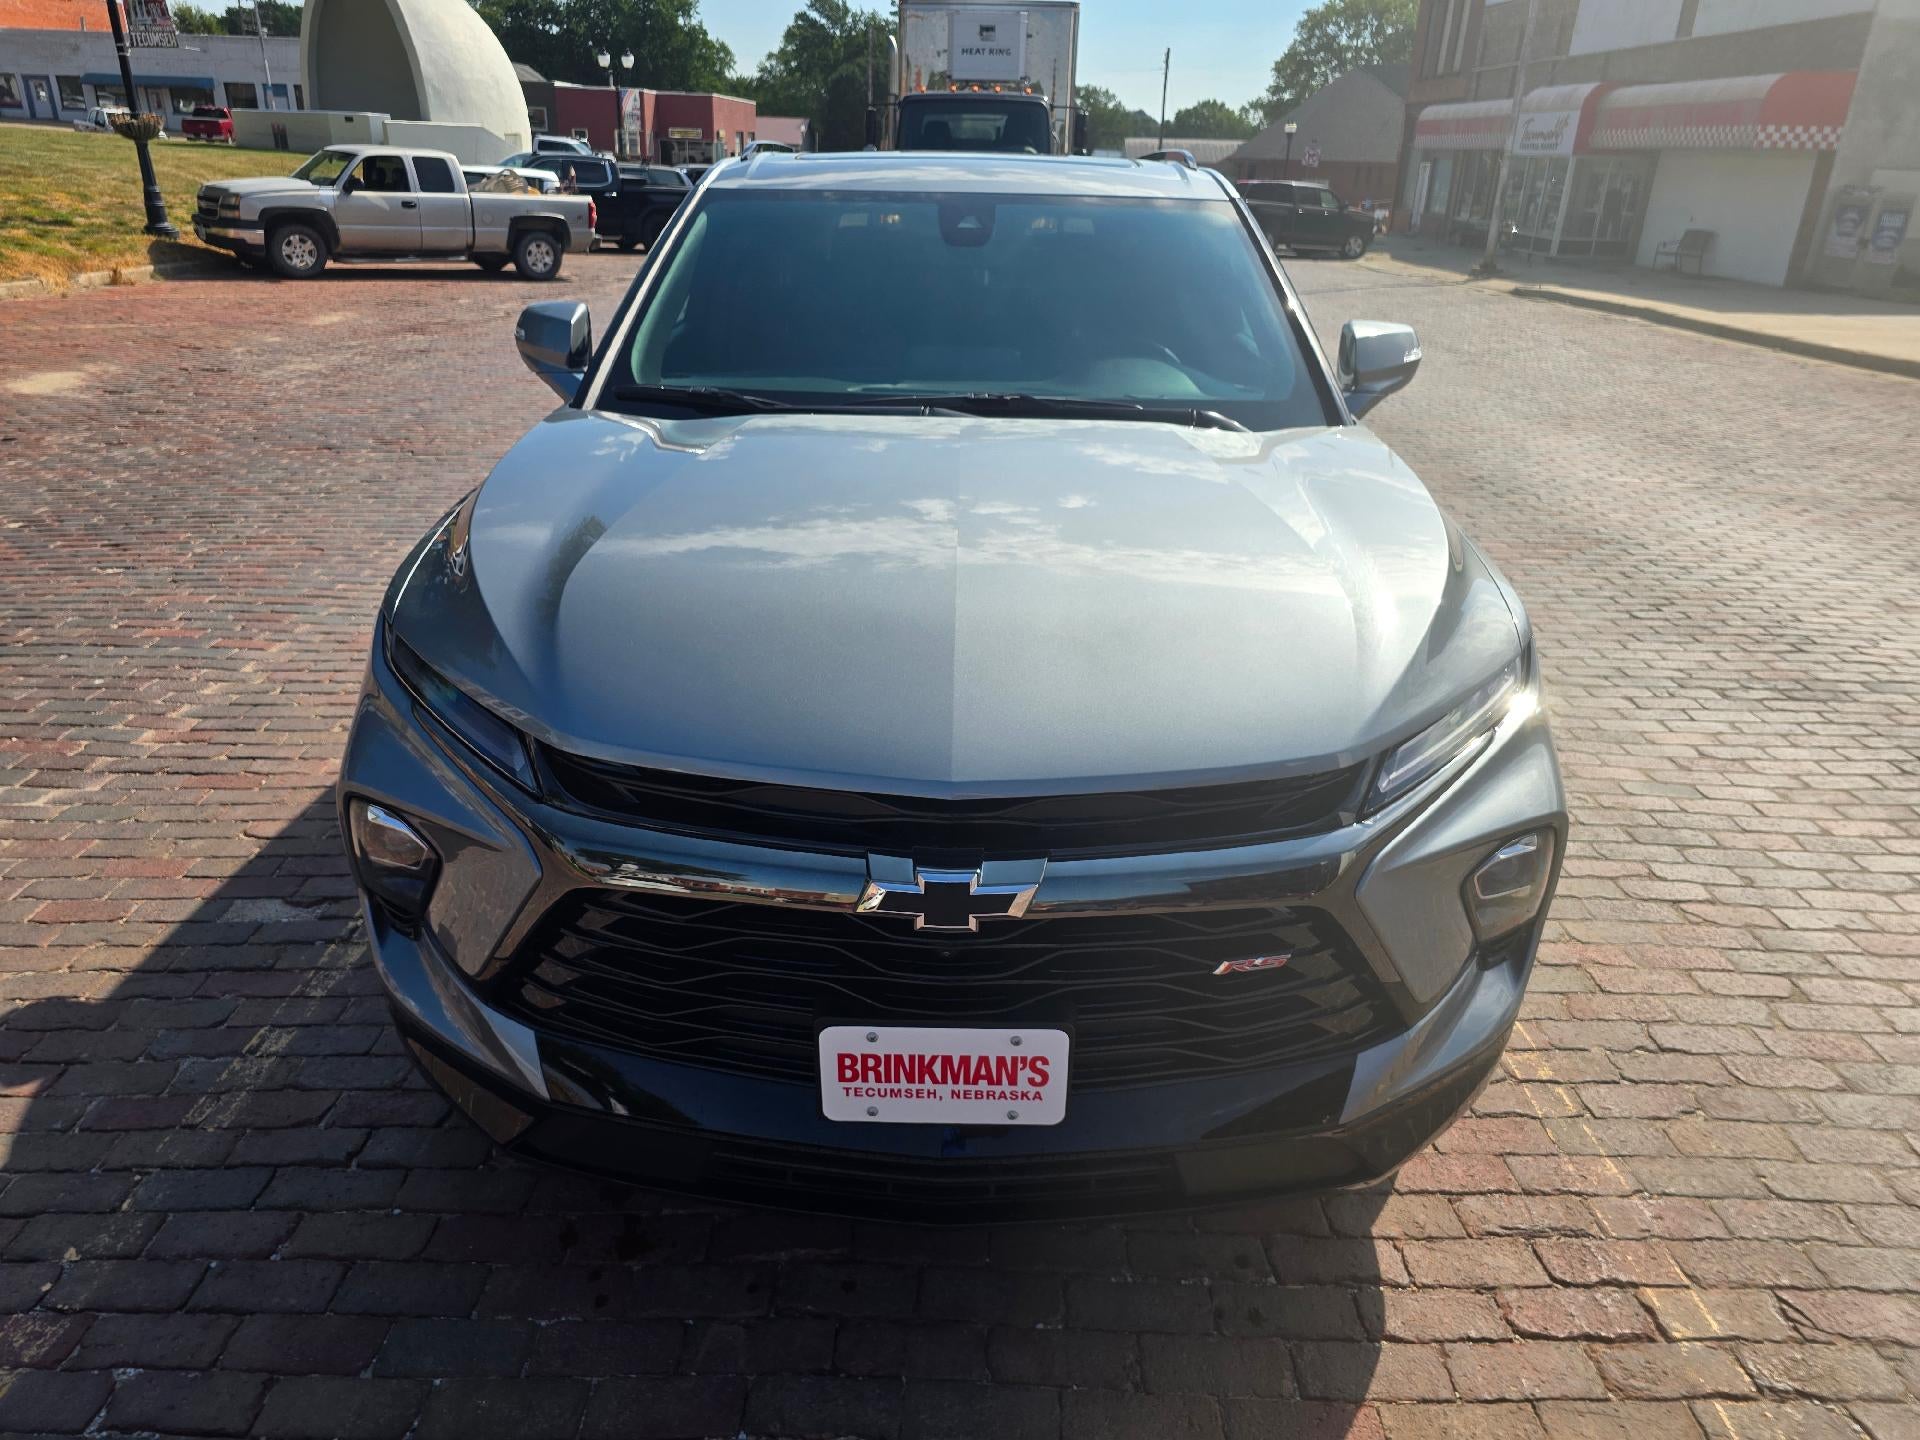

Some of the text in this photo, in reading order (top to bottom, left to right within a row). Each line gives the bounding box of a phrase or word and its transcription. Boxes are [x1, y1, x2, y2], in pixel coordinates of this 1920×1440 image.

[130, 31, 177, 47] TECUMSEH
[961, 47, 985, 56] HEAT
[836, 1053, 1050, 1087] BRINKMAN'S
[842, 1087, 1043, 1101] TECUMSEH, NEBRASKA
